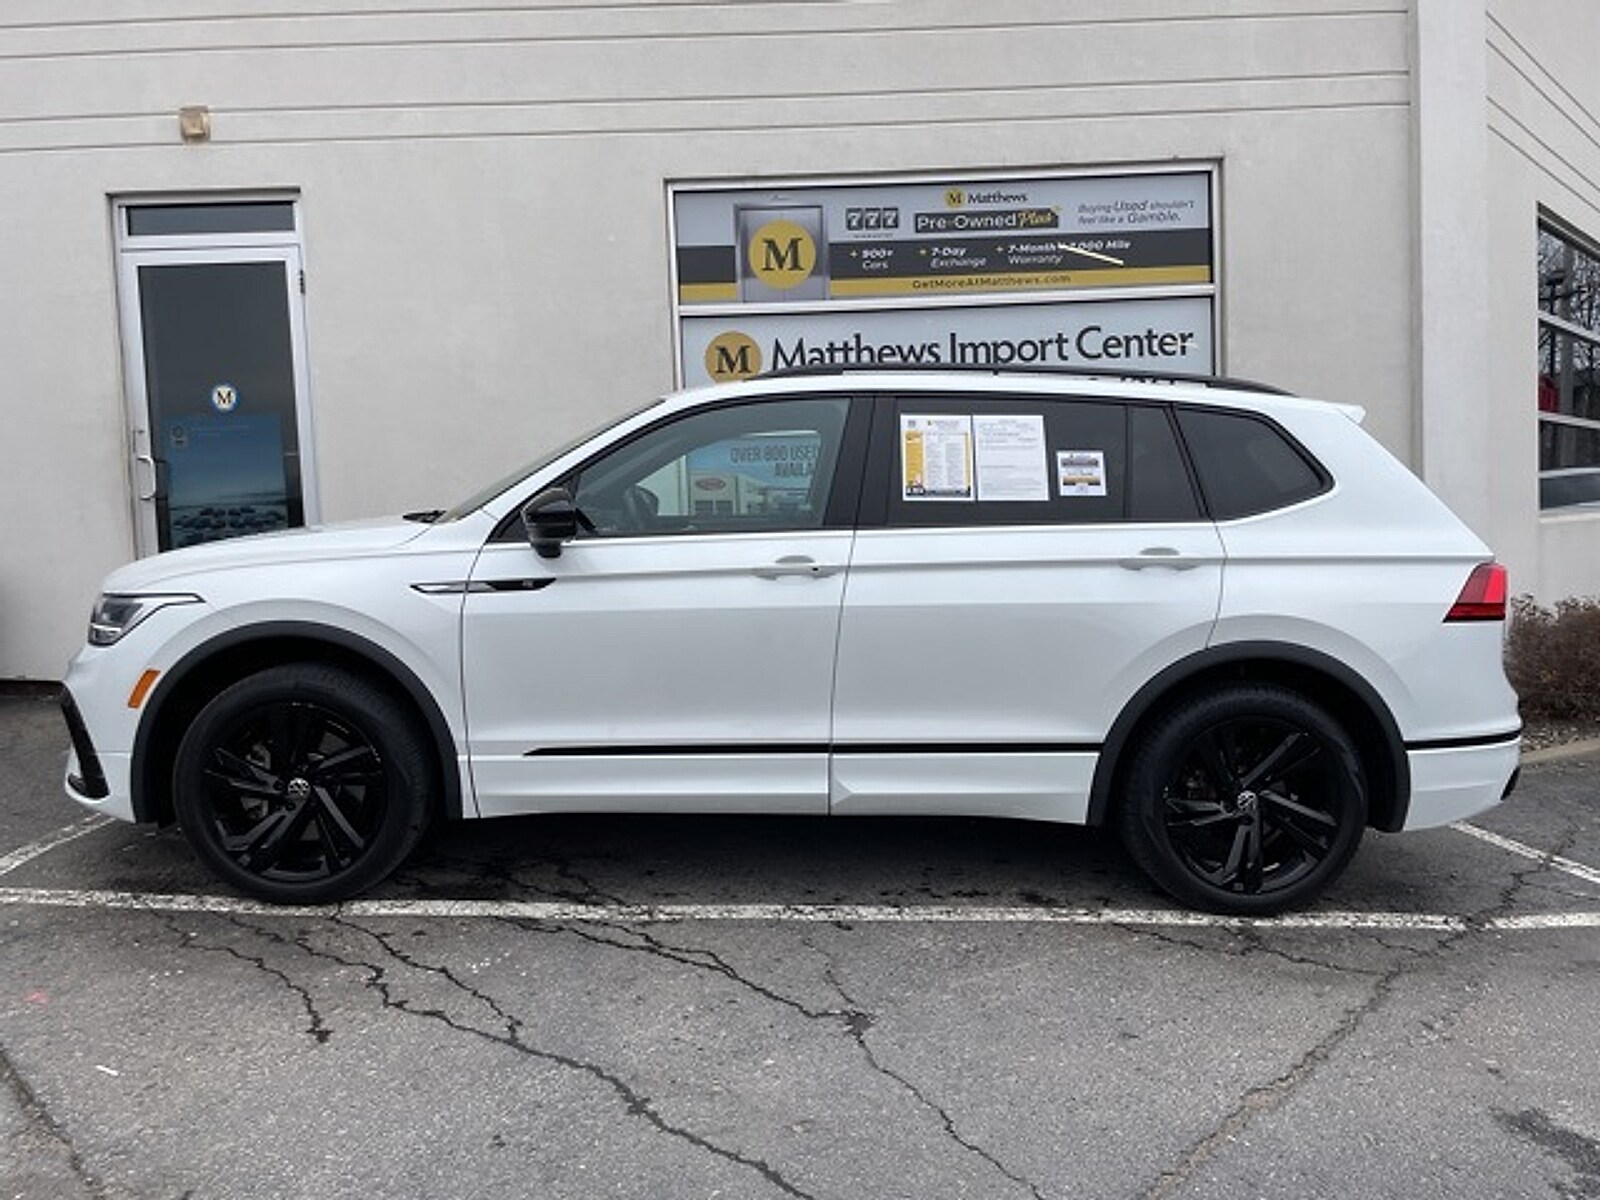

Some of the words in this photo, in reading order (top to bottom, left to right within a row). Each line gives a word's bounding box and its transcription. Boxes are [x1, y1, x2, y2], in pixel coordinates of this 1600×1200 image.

[967, 192, 1029, 206] Matthews
[1113, 200, 1148, 212] Used
[917, 211, 1017, 230] Pre-Owned
[762, 237, 804, 271] M
[1007, 255, 1063, 266] Warranty
[862, 260, 889, 270] Cars
[931, 257, 987, 269] Exchange
[715, 345, 752, 374] M
[772, 332, 942, 371] Matthews
[950, 332, 1069, 364] Import
[1077, 325, 1194, 359] Center
